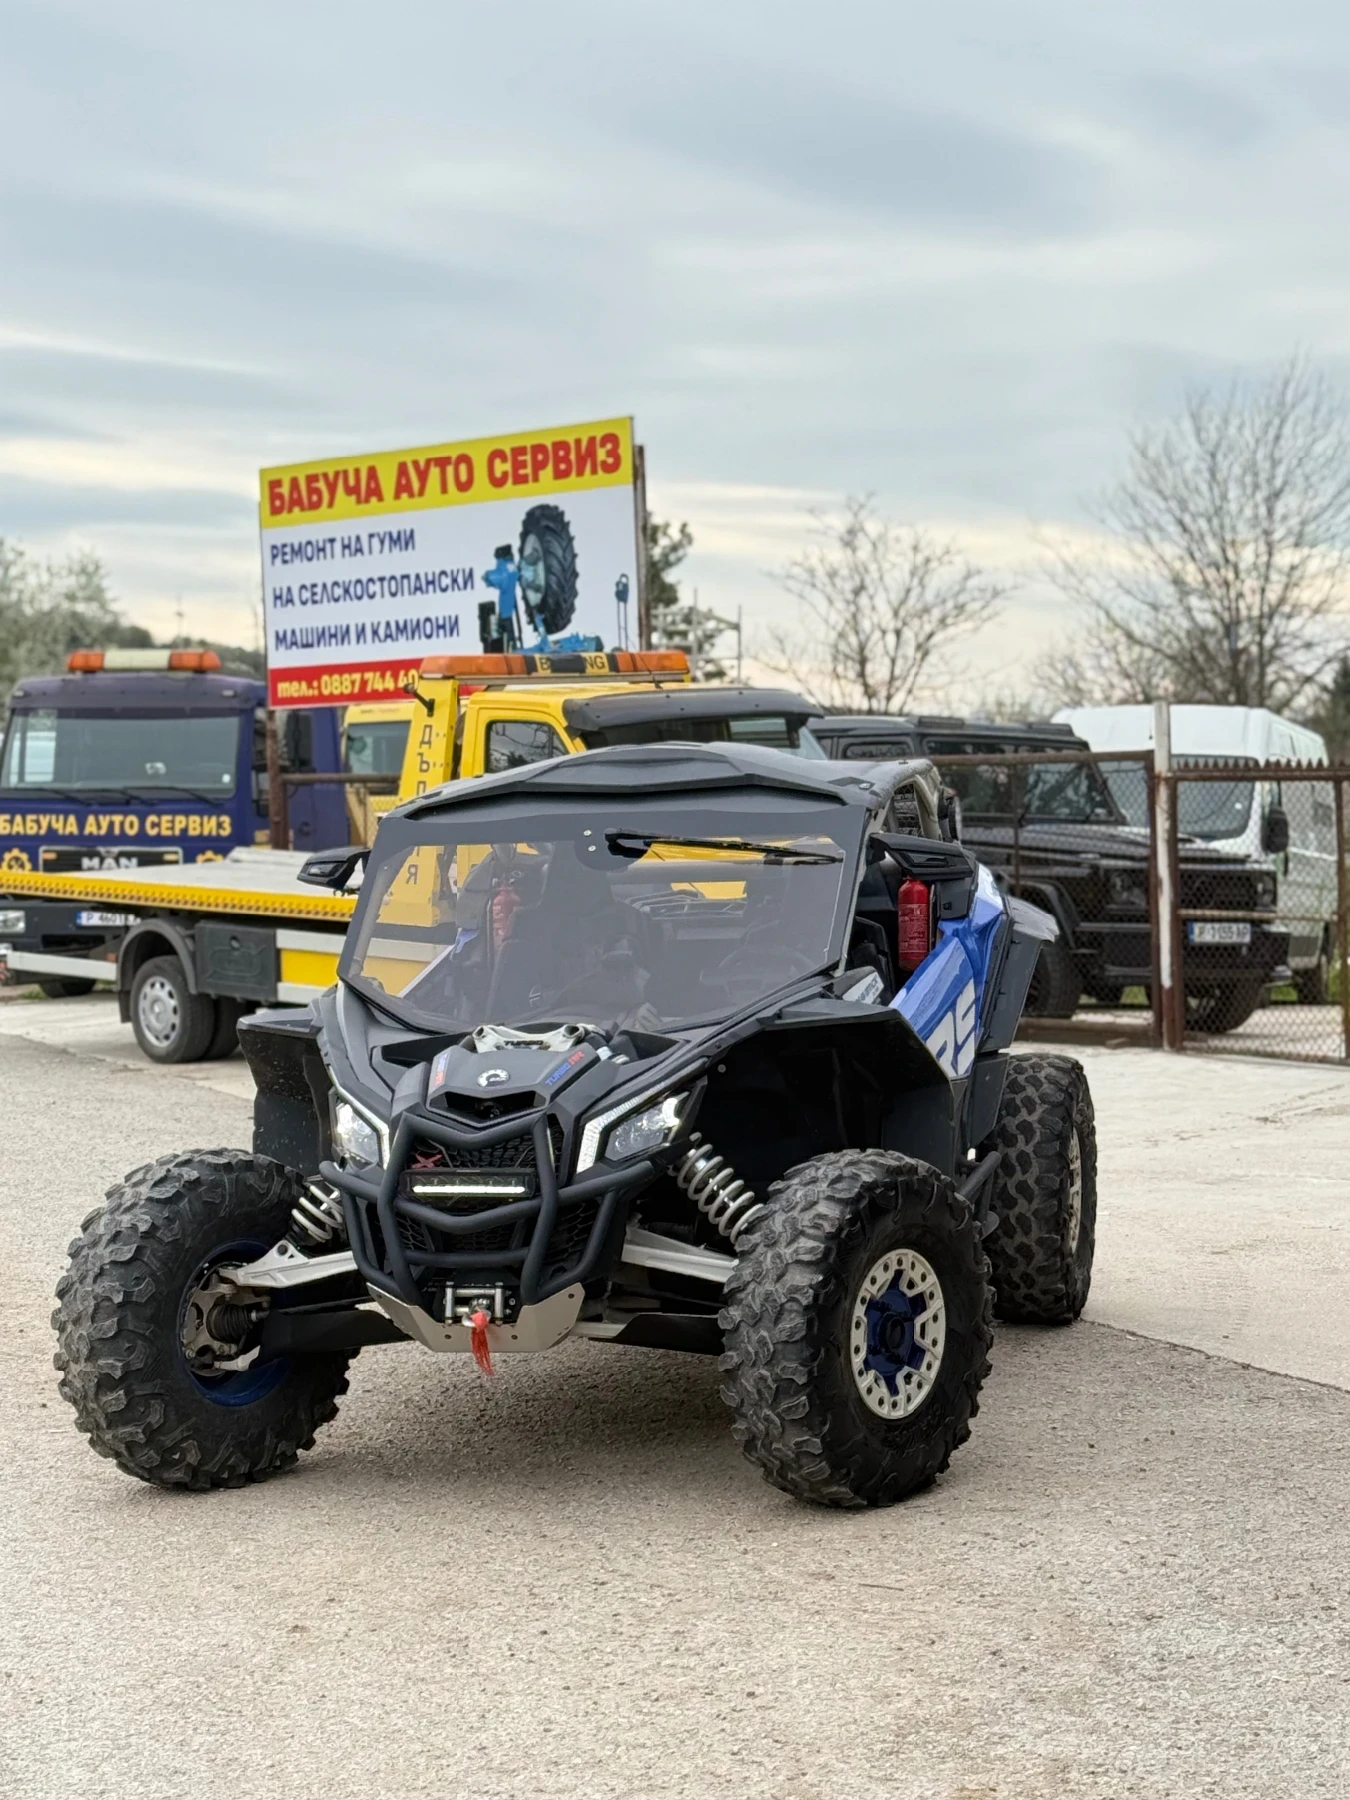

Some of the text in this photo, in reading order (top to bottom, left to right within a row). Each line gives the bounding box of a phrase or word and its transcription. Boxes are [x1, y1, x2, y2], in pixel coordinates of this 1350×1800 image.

[268, 432, 622, 516] БАБУЧА АУТО СЕРВИЗ
[270, 528, 416, 566] РЕМОНТ НА ГУМИ
[273, 567, 475, 609] НА СЕЛСКОСТОПАНСКИ
[275, 614, 460, 651] МАШИНИ И КАМИОНИ
[320, 672, 362, 695] 0887
[363, 670, 395, 693] 744
[0, 814, 232, 837] БАБУЧА АУТО СЕРВИЗ
[81, 857, 138, 870] MAN
